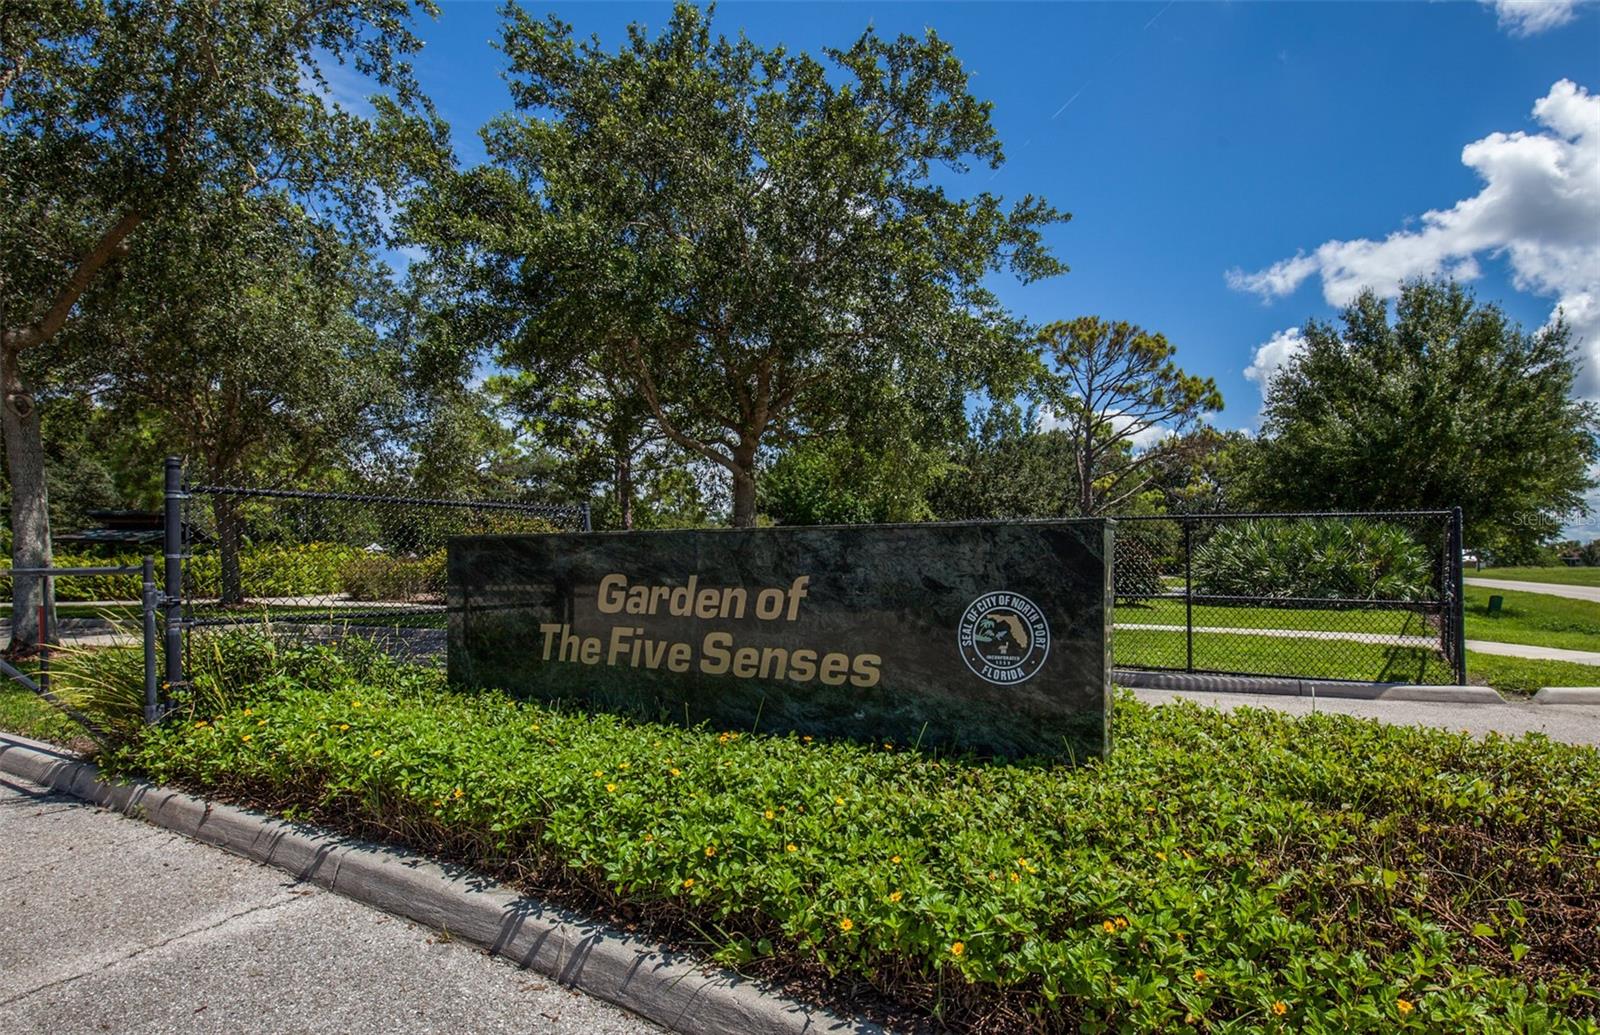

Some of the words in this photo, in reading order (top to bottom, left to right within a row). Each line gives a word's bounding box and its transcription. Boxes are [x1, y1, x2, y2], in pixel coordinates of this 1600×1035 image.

[597, 573, 748, 619] Garden
[755, 575, 809, 621] of
[976, 596, 997, 612] CITY
[998, 595, 1011, 605] OF
[967, 609, 978, 622] OF
[1011, 597, 1040, 622] NORTH
[962, 624, 973, 647] SEAL
[1033, 623, 1046, 649] PORT
[540, 623, 601, 665] The
[607, 626, 692, 673] Five
[701, 632, 881, 688] Senses
[982, 666, 1025, 680] FLORIDA
